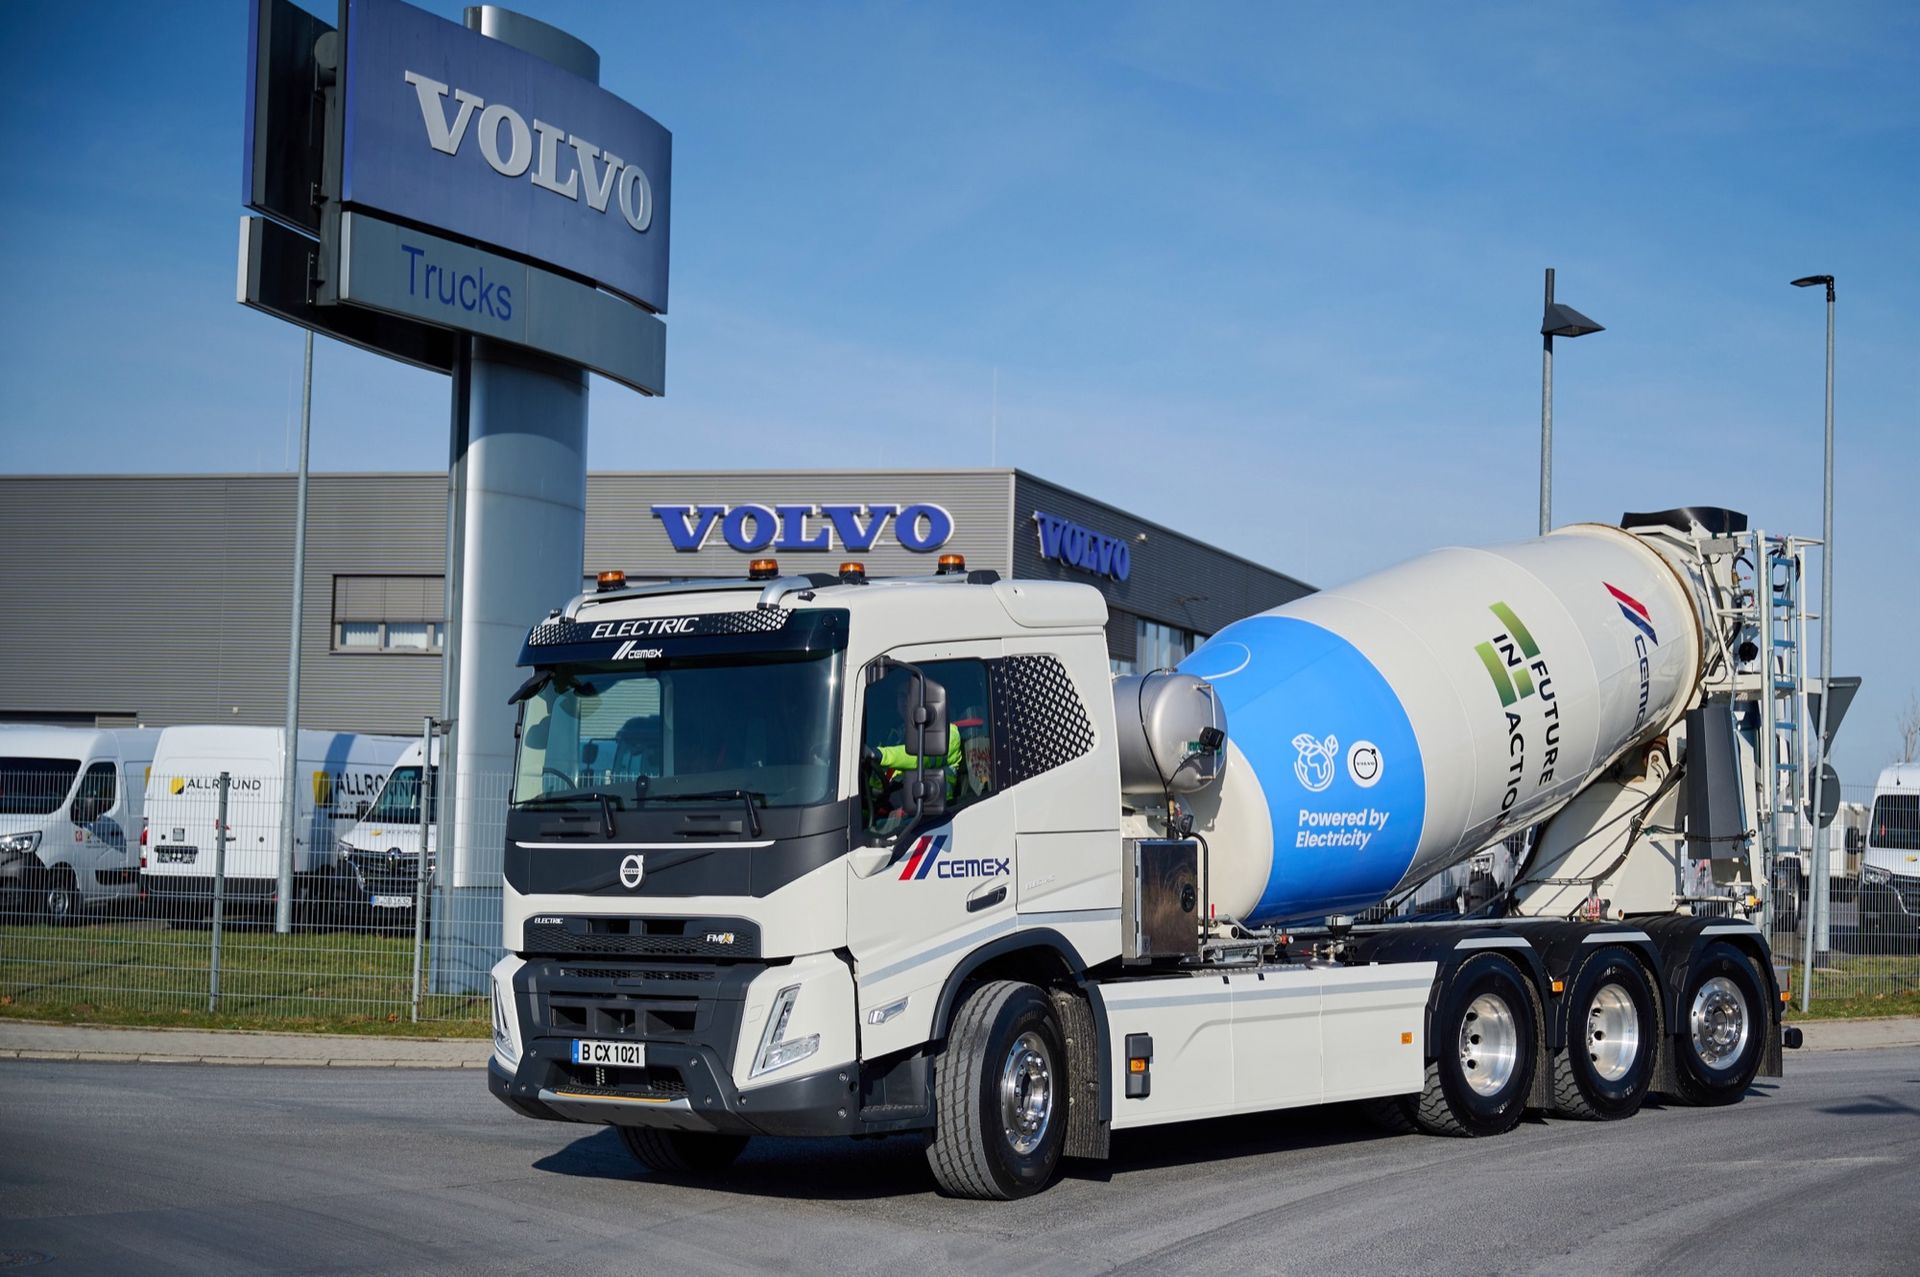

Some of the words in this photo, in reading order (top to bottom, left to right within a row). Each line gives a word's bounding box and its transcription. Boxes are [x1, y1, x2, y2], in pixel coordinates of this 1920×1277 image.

[404, 70, 653, 233] VOLVO
[401, 244, 513, 322] Trucks
[651, 503, 955, 554] VOLVO
[1032, 510, 1131, 582] VOLVO
[591, 617, 699, 639] ELECTRIC
[627, 648, 663, 660] CEMEX
[1493, 633, 1522, 668] IN
[1631, 634, 1650, 736] CEME
[1530, 660, 1560, 787] FUTURE
[187, 778, 262, 791] ALLRUND
[1298, 808, 1368, 827] Powered
[1368, 808, 1390, 831] by
[1295, 828, 1372, 851] Electricity
[937, 857, 1010, 879] CEMEX
[582, 1043, 590, 1061] B
[594, 1044, 611, 1063] CX
[614, 1045, 640, 1064] 1021
